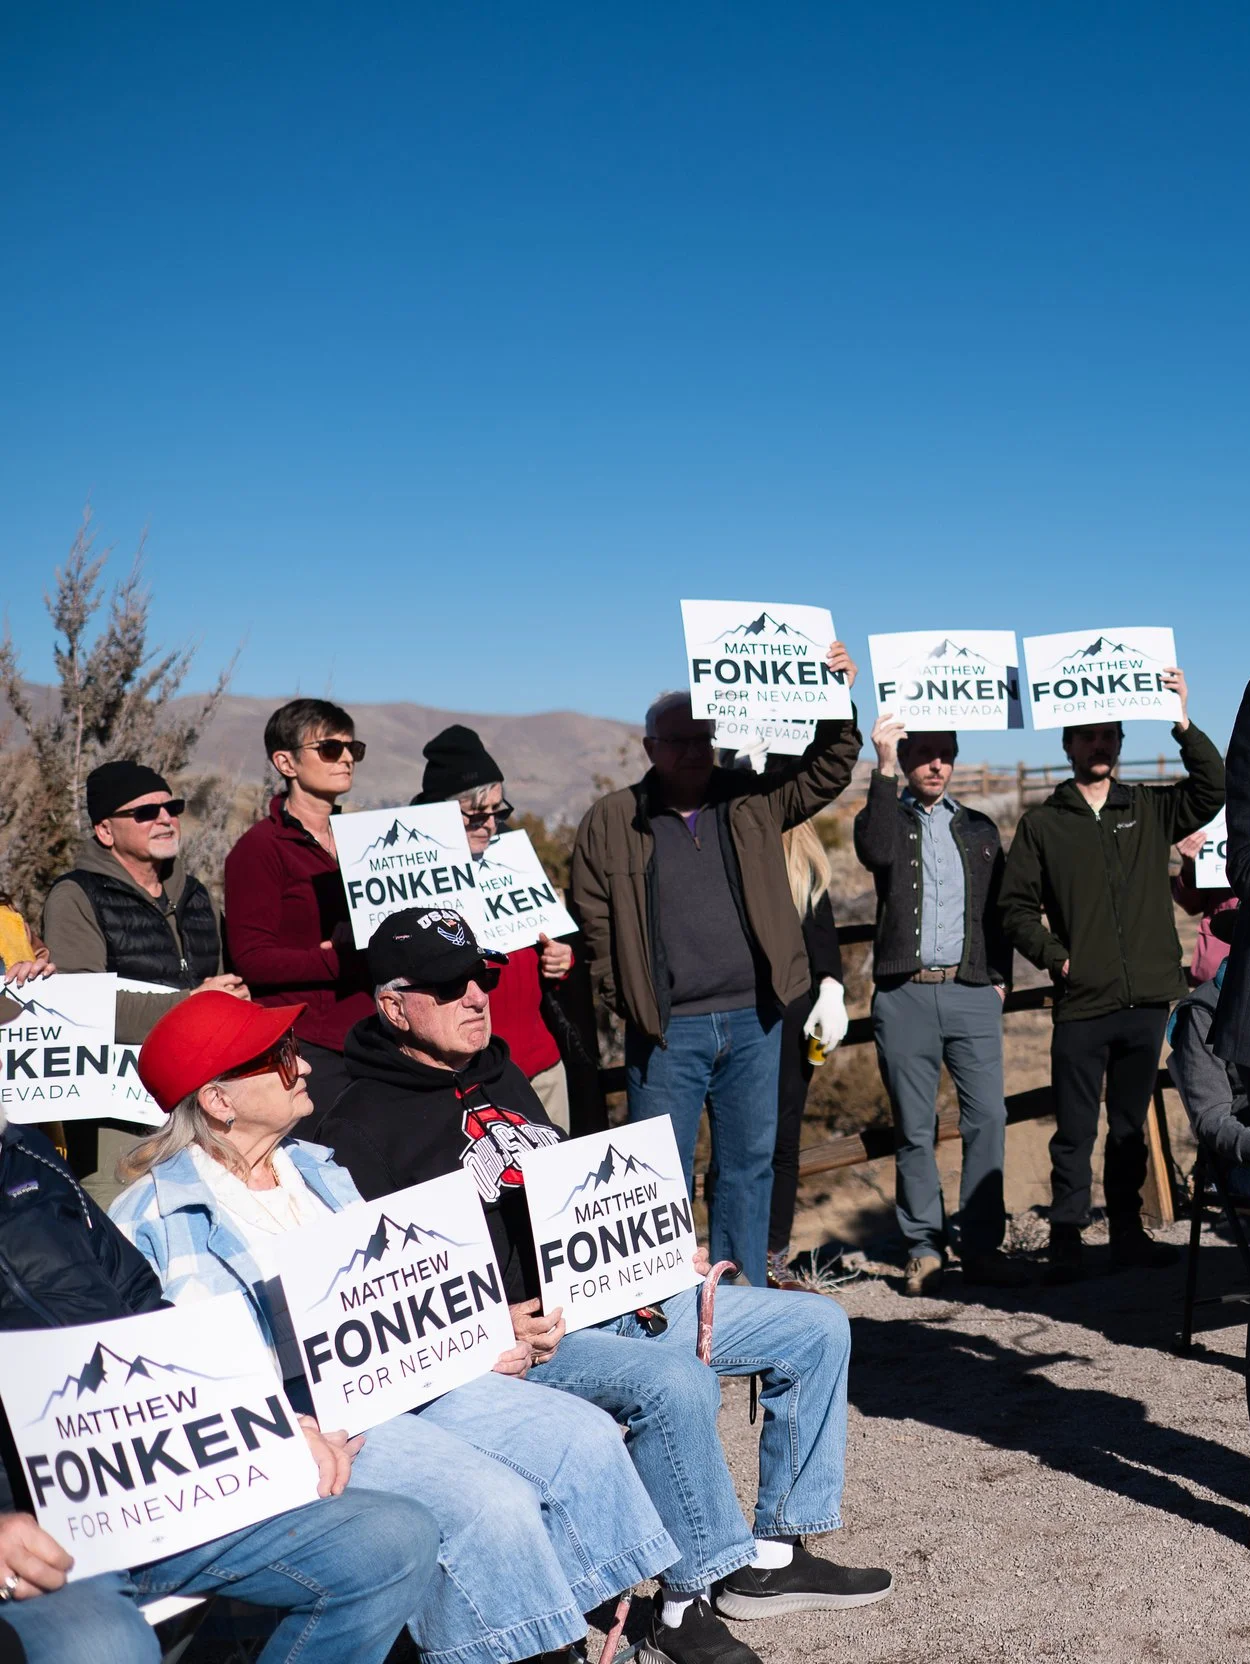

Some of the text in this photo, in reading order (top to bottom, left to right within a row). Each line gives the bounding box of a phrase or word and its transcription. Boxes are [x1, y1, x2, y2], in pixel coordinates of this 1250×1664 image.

[724, 642, 808, 656] MATTHEW
[692, 658, 846, 686] FONKEN
[917, 665, 986, 676] ATTHEW
[1062, 659, 1144, 676] MATTHEW
[706, 702, 748, 718] PARA
[757, 690, 828, 703] NEVADA
[900, 705, 1003, 716] FOR NEVADA
[1053, 696, 1163, 714] FOR NEVADA
[716, 721, 749, 735] FOR
[755, 725, 810, 741] NEVADA
[369, 849, 439, 872] MATTHEW
[347, 862, 477, 910] FONKEN
[484, 882, 557, 922] KEN
[483, 913, 550, 941] NEVADA
[574, 1182, 658, 1225] MATTHEW
[539, 1197, 693, 1285] FONKEN
[339, 1250, 450, 1313] MATTHEW
[569, 1248, 685, 1304] FOR NEVADA
[302, 1262, 503, 1385] FONKEN
[342, 1323, 489, 1404] FOR NEVADA
[55, 1386, 198, 1440] MATTHEW
[25, 1394, 295, 1509] FONKEN
[67, 1464, 270, 1542] FOR NEVADA
